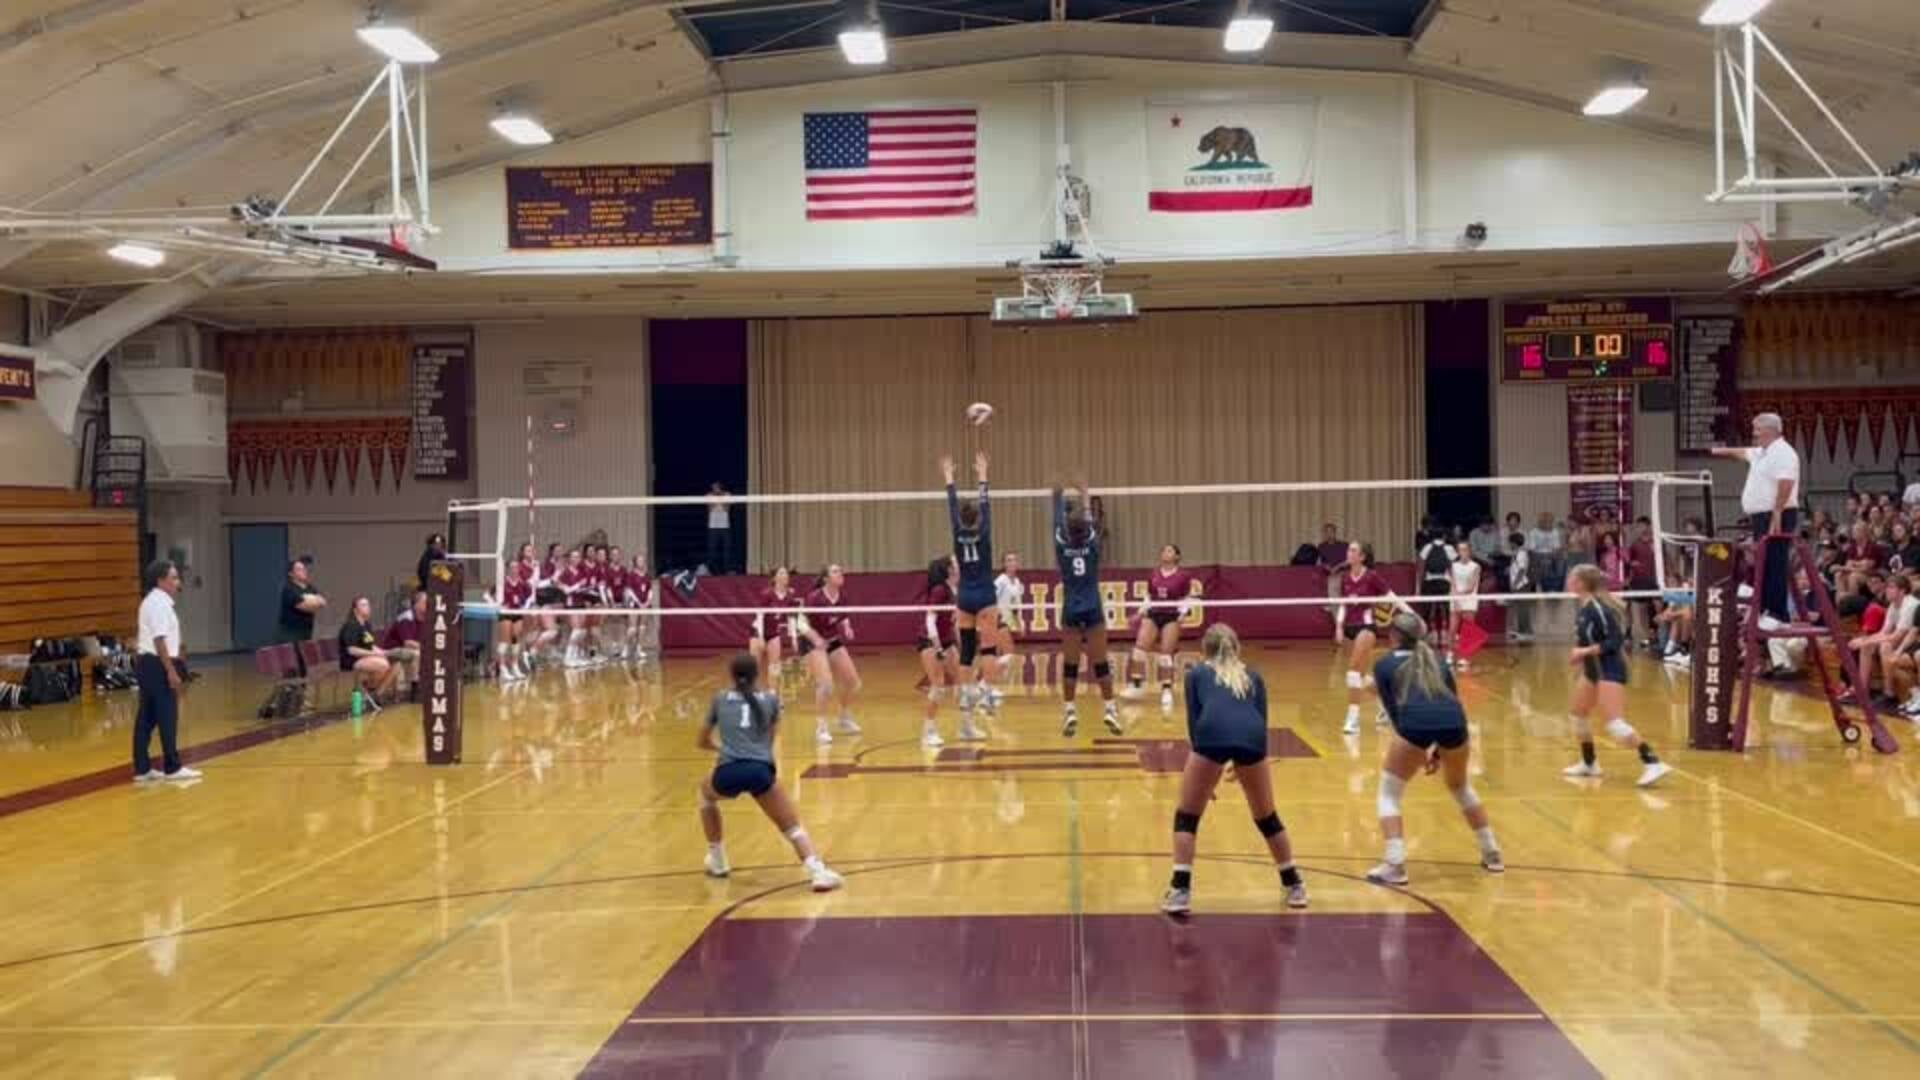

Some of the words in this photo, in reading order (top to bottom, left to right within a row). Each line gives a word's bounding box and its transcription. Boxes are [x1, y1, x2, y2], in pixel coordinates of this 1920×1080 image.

[1184, 174, 1230, 186] CALIFORNIA
[963, 544, 980, 563] 11
[1072, 557, 1086, 576] 9
[434, 594, 447, 650] LAS
[1705, 586, 1723, 724] KNIGHTS
[431, 659, 447, 752] LOMAS
[740, 703, 751, 728] 1
